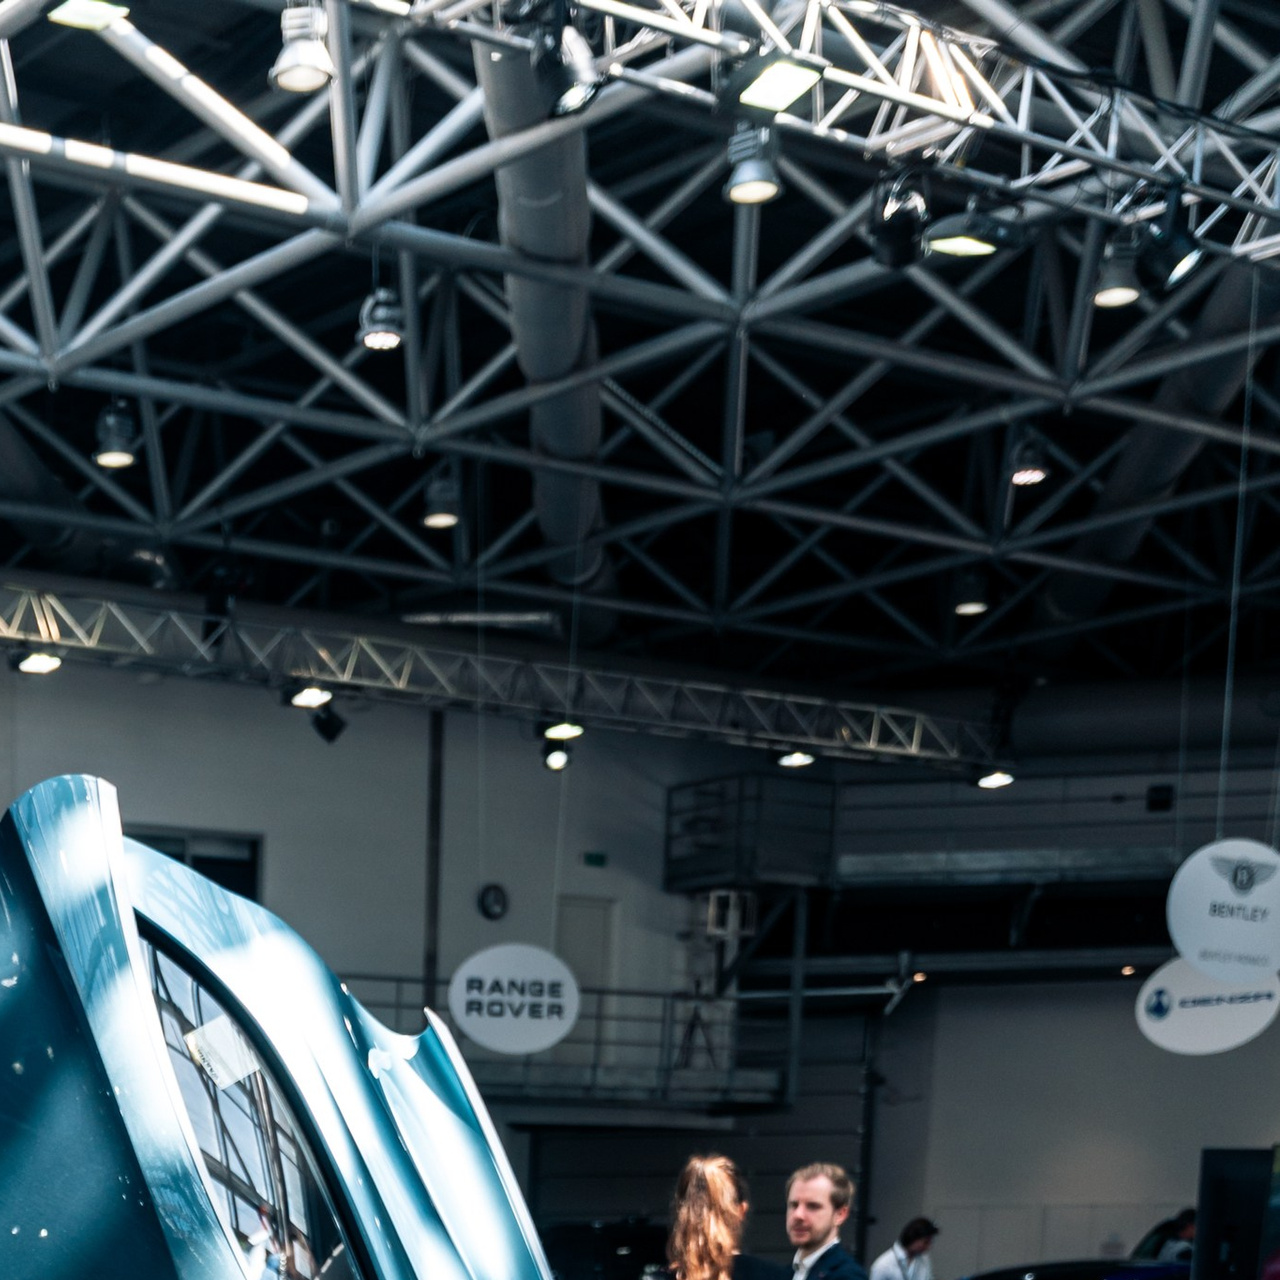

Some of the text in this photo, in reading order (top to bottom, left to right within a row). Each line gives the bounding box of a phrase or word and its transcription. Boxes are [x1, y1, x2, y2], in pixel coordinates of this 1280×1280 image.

[1208, 901, 1269, 922] BENTLEY
[465, 976, 563, 999] RANGE
[465, 999, 564, 1021] ROVER
